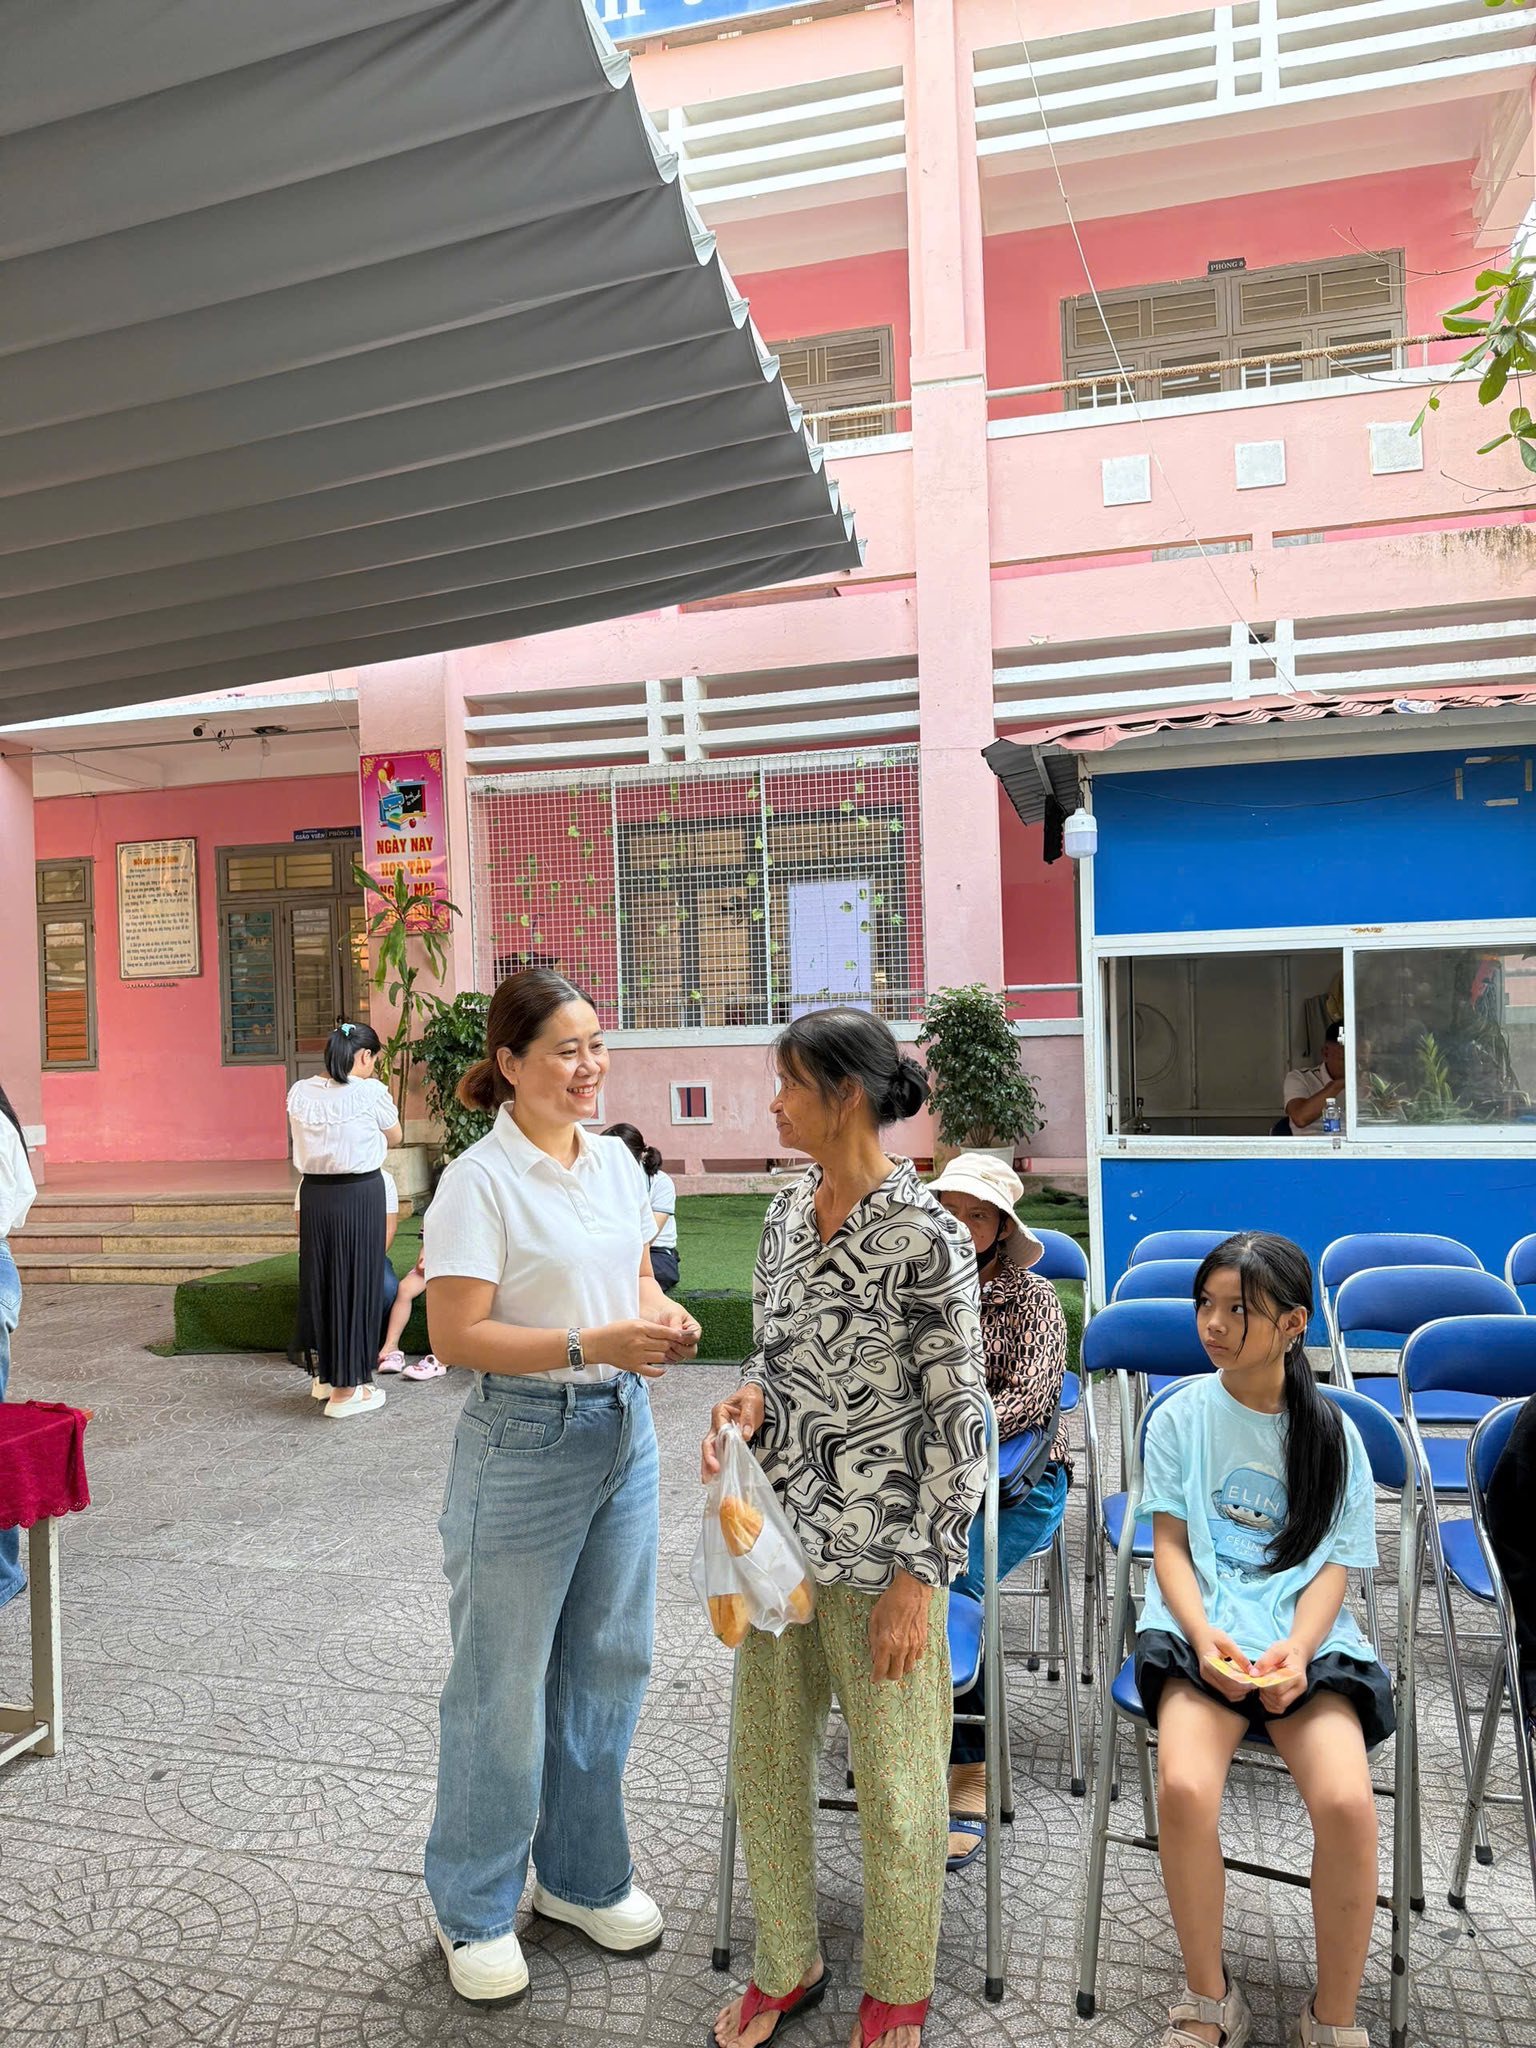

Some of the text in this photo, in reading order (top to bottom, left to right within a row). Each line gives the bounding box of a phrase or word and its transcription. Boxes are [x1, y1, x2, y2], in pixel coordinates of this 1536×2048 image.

[1211, 261, 1238, 271] PHÒNG
[376, 835, 433, 854] NGÀY NAY
[381, 856, 432, 880] HỌ TẬP
